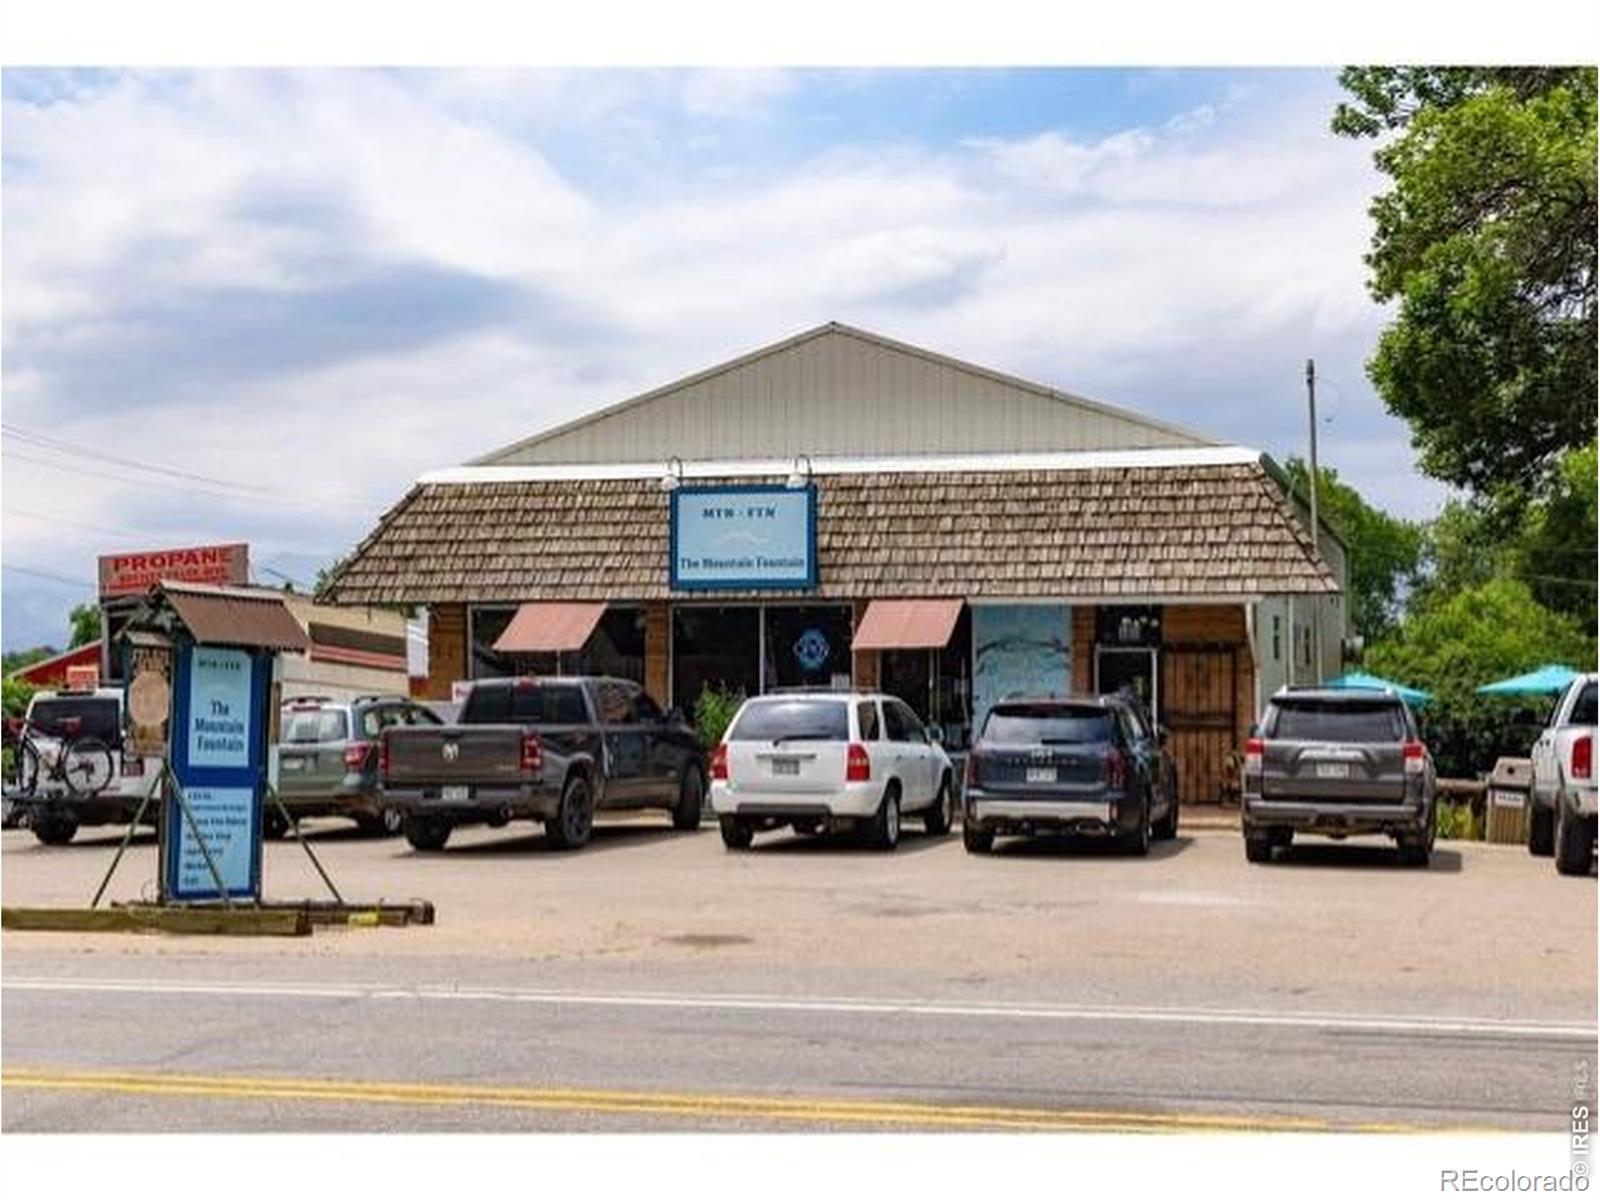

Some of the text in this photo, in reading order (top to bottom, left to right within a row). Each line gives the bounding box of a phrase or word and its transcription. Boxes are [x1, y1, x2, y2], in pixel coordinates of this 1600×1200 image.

[113, 548, 233, 573] PROPANE
[681, 556, 805, 570] The Mountain Fountain
[211, 699, 230, 716] The
[195, 717, 245, 735] Mountain
[197, 735, 245, 752] Fountain
